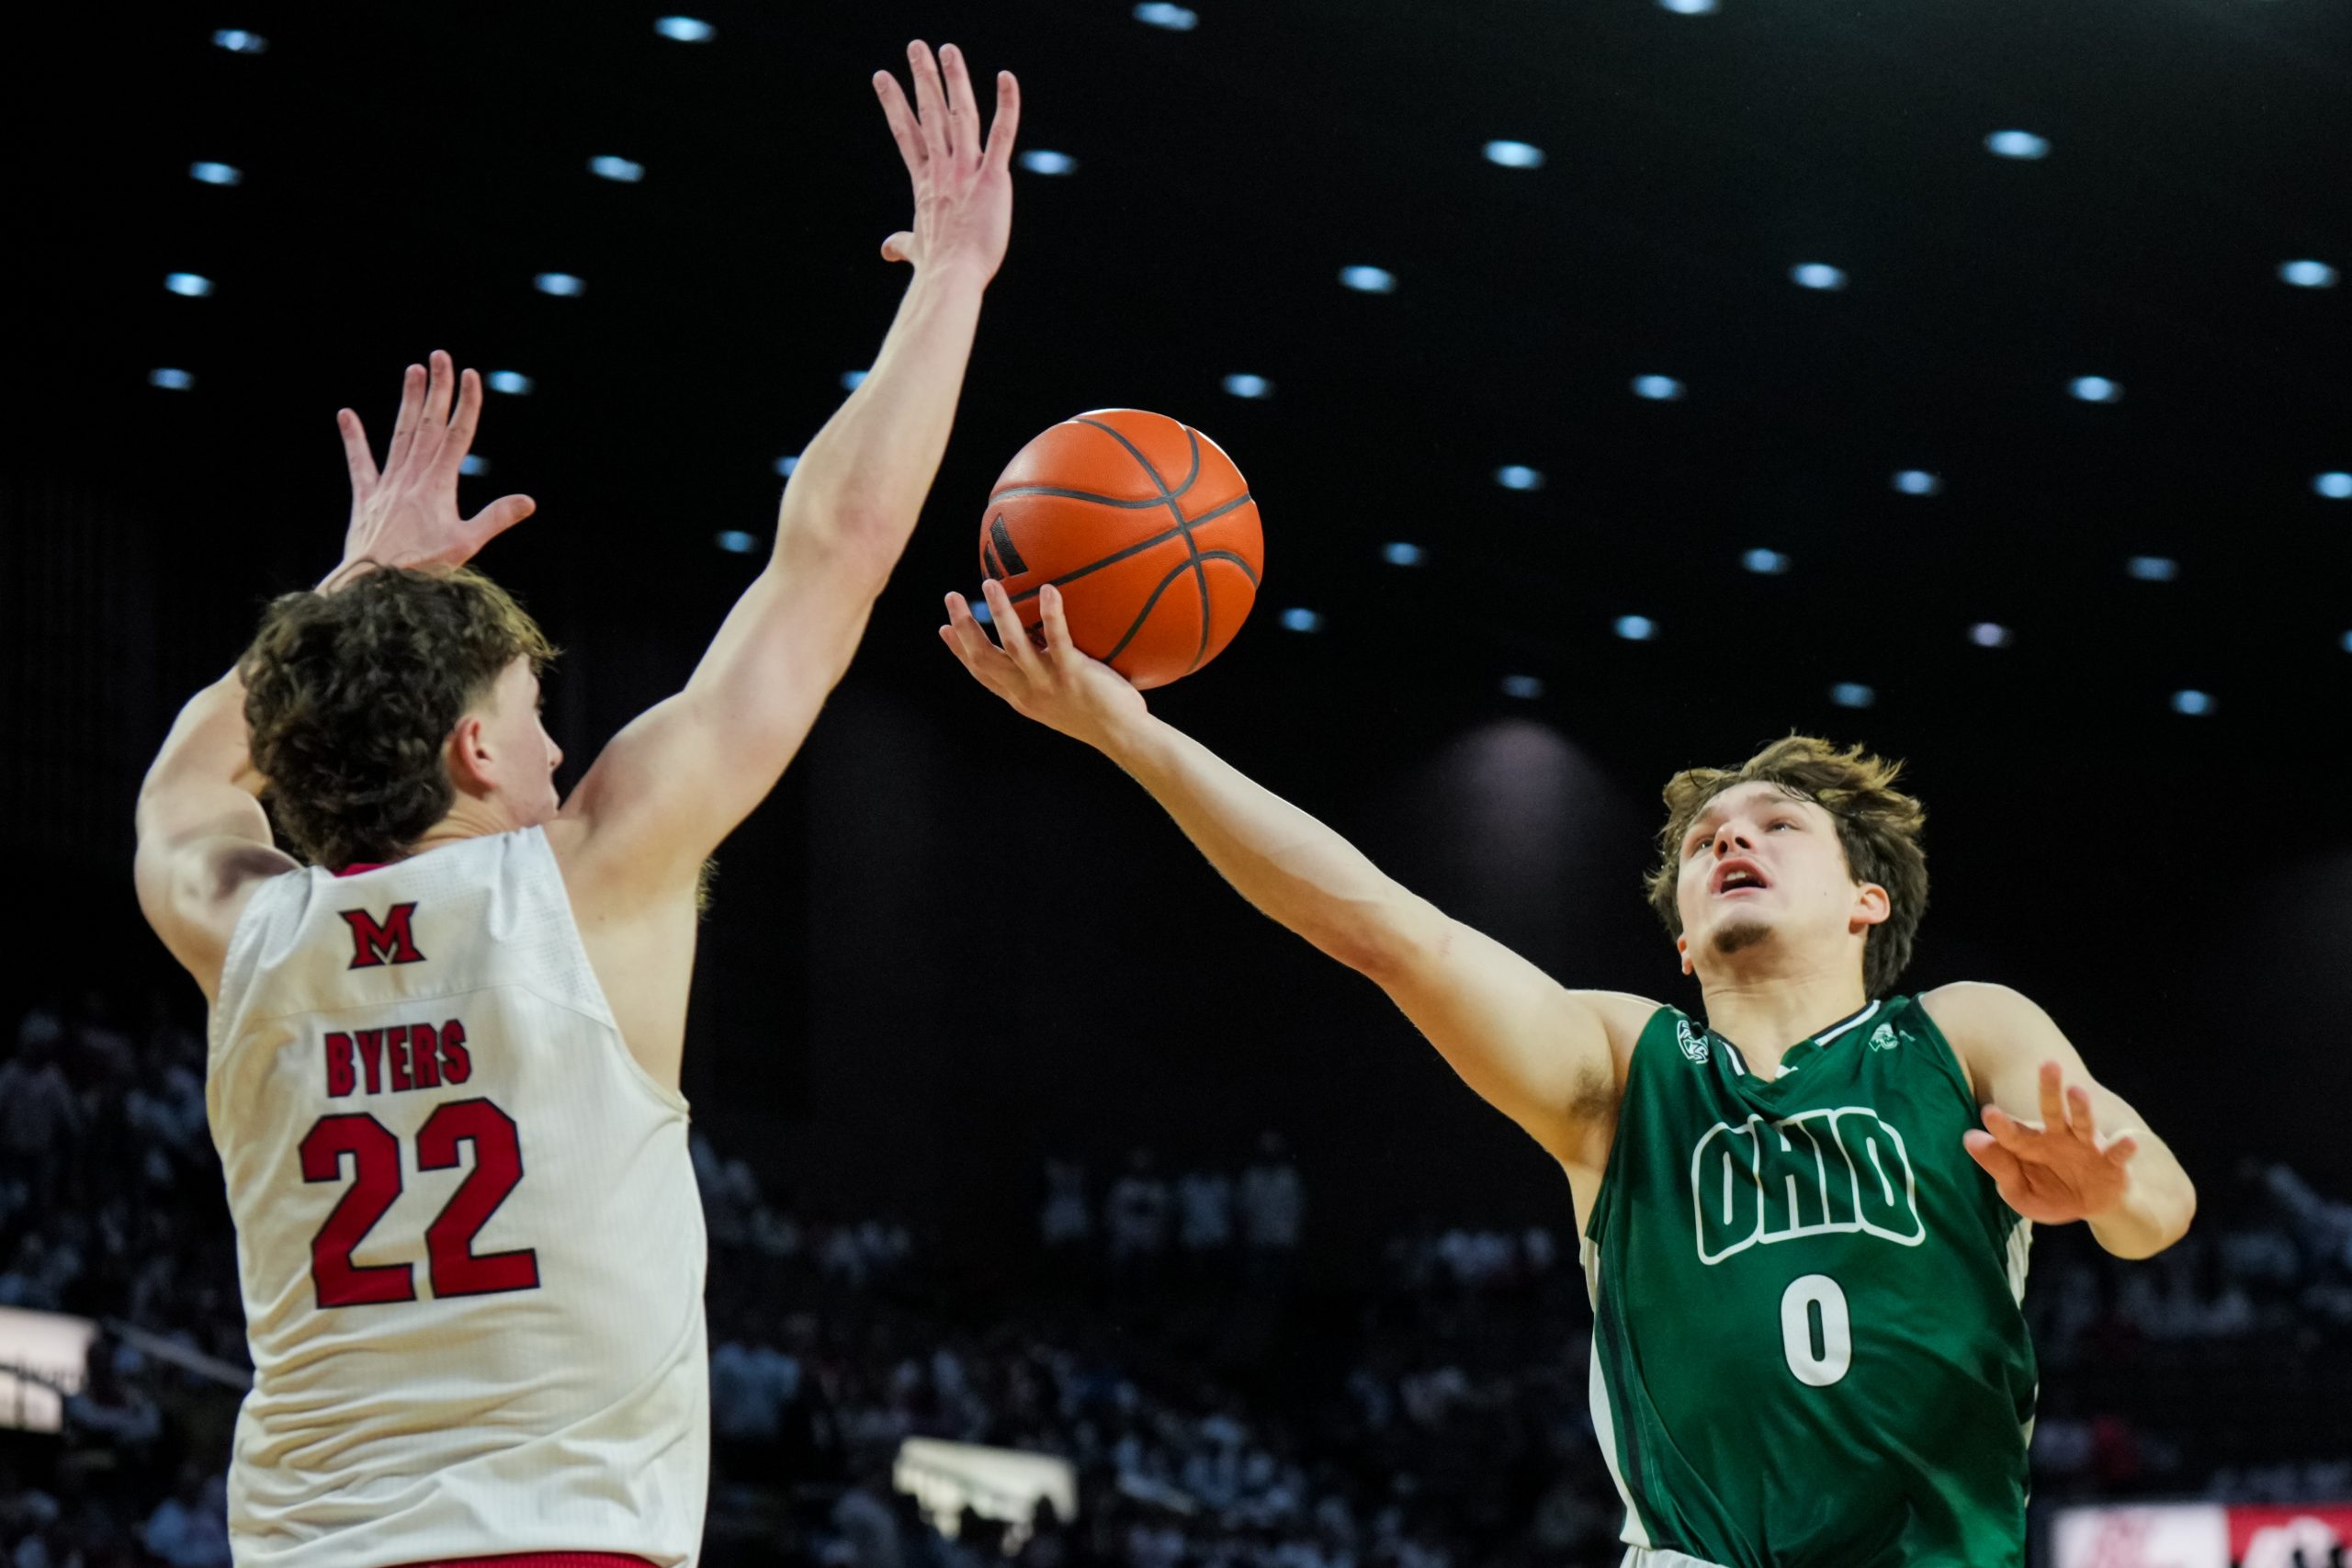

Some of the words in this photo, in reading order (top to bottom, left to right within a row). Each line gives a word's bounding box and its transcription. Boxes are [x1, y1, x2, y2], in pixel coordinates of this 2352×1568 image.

[338, 902, 426, 970] M
[324, 1019, 471, 1099] BYERS
[299, 1097, 541, 1309] 22
[1691, 1107, 1926, 1265] OHIO
[1781, 1274, 1851, 1387] 0
